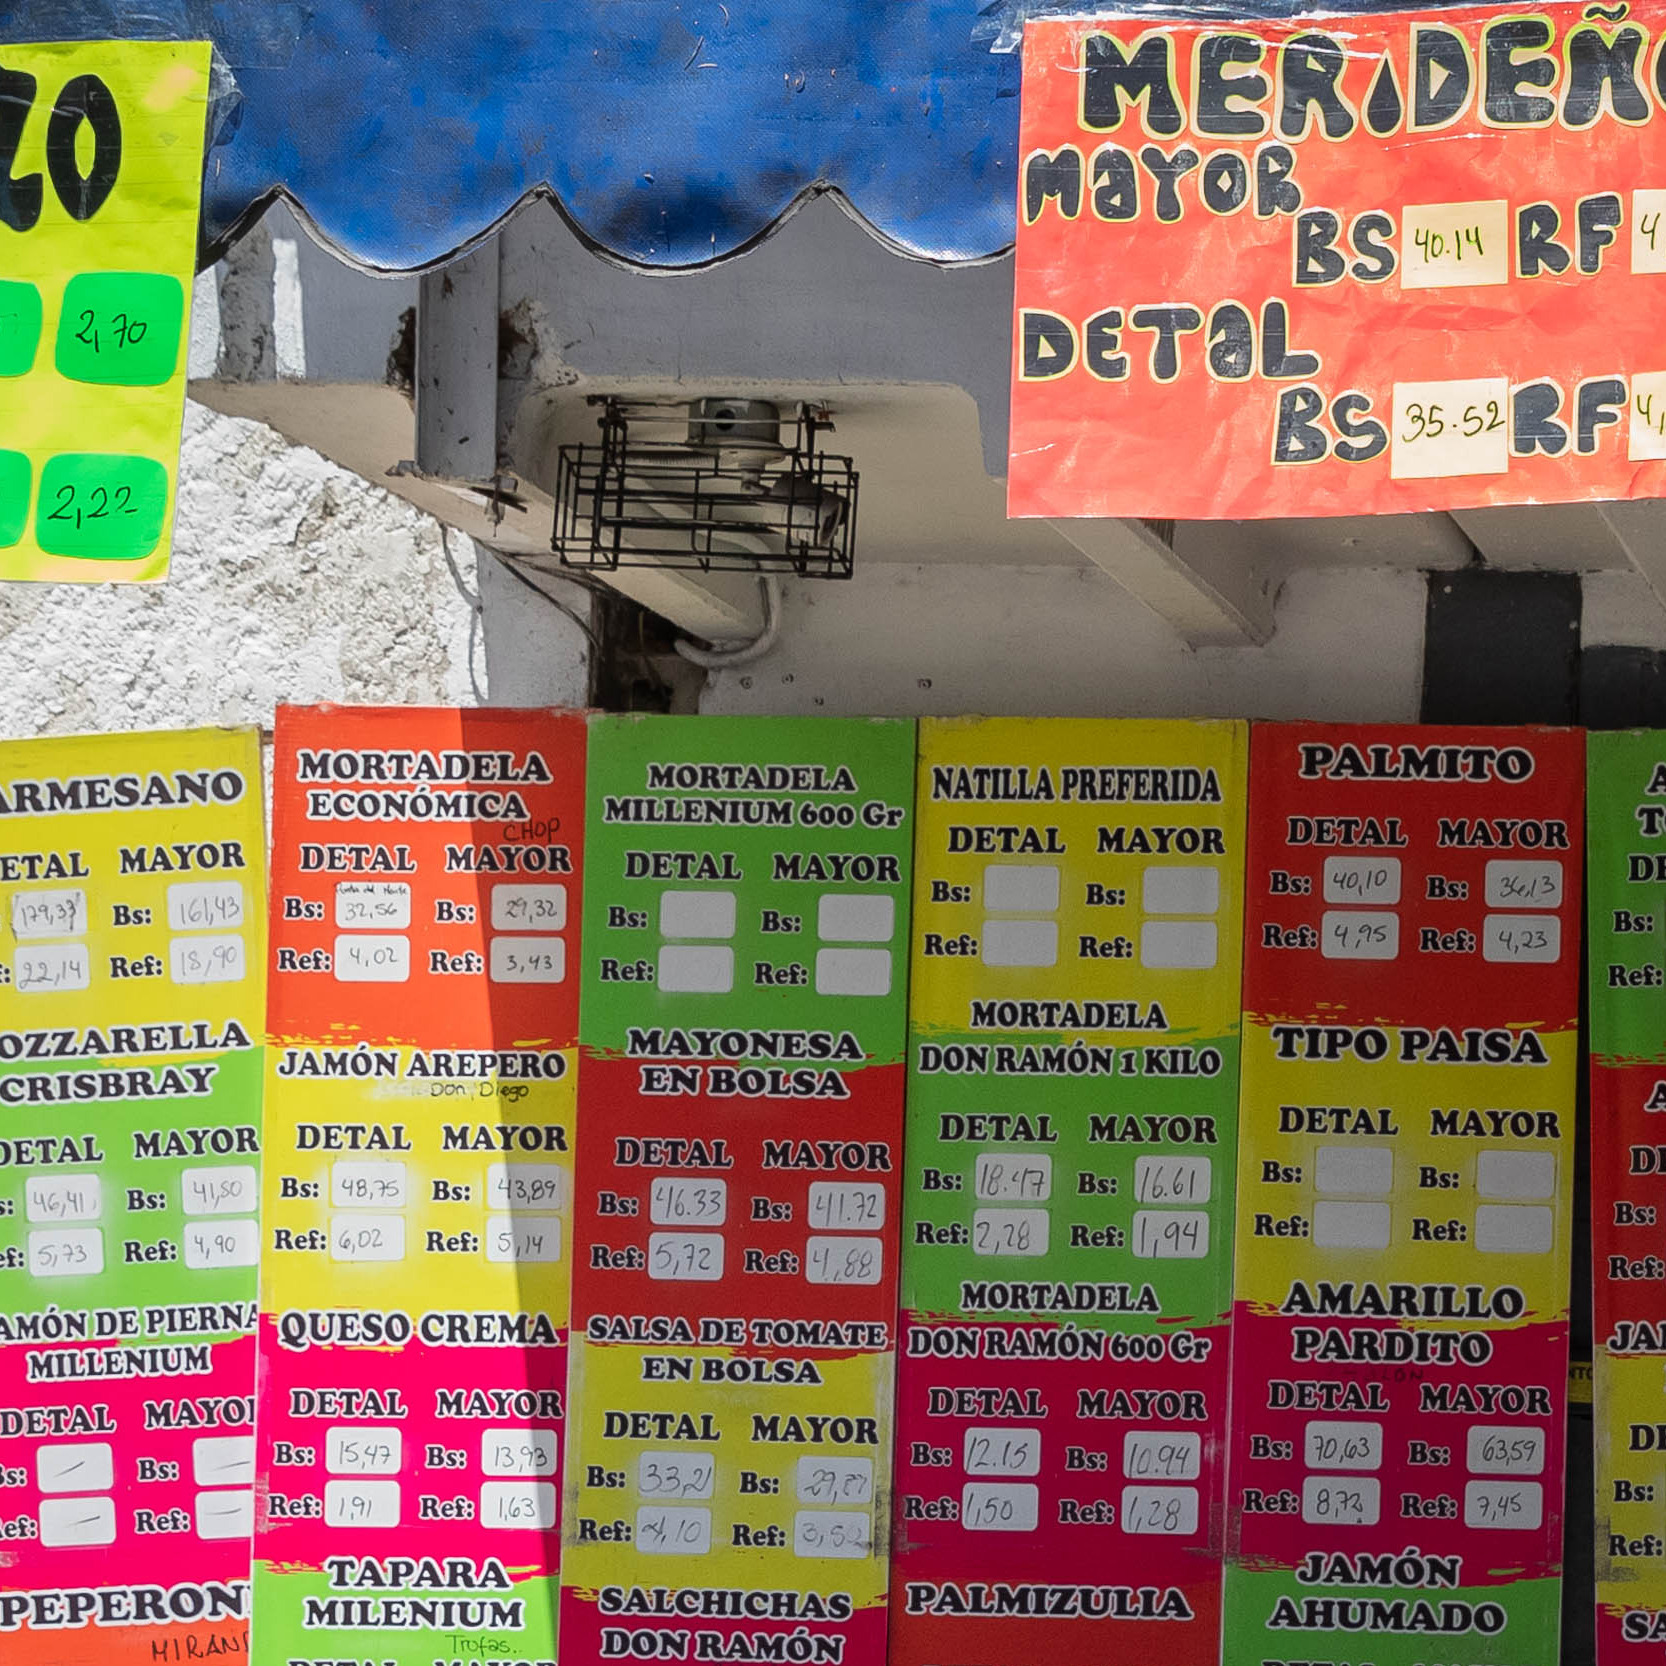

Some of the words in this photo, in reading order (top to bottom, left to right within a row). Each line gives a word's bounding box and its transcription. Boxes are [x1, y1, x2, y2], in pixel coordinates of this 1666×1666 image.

[1294, 207, 1398, 287] BS
[1415, 227, 1482, 258] 40.14
[1517, 193, 1622, 276] RF
[78, 310, 147, 344] 2,70
[1273, 384, 1388, 465] BS
[1403, 401, 1505, 441] 35.52
[1510, 376, 1627, 458] RF
[48, 487, 137, 521] 2,22
[298, 751, 551, 784] MORTADELA
[648, 765, 856, 792] MORTADELA
[1299, 745, 1534, 782] PALMITO
[933, 767, 1057, 802] NATILLA
[1062, 767, 1221, 803] PREFERIDA
[310, 788, 529, 821] ECONÓMICA
[604, 798, 793, 826] MILLENIUM
[799, 803, 855, 827] 600
[861, 803, 903, 827] Gr
[1286, 818, 1407, 847] DETAL
[1437, 819, 1569, 849] MAYOR
[119, 842, 245, 874] MAYOR
[301, 846, 416, 873] DETAL
[445, 846, 572, 873] MAYOR
[1270, 870, 1311, 895] Bs:
[113, 905, 152, 926] Bs:
[1262, 923, 1317, 950] Ref:
[110, 954, 163, 977] Ref:
[970, 1001, 1168, 1031] MORTADELA
[279, 1044, 398, 1078] JAMÓN
[407, 1052, 565, 1079] AREPERO
[627, 1029, 863, 1061] MAYONESA
[919, 1046, 993, 1075] DON
[995, 1039, 1117, 1075] RAMÓN
[1144, 1048, 1221, 1076] KILO
[1273, 1026, 1388, 1062] TIPO
[1399, 1027, 1548, 1065] PAISA
[639, 1069, 701, 1096] EN
[707, 1069, 849, 1098] BOLSA
[341, 1177, 400, 1199] 48,75
[497, 1177, 557, 1204] 43,89
[961, 1283, 1160, 1313] MORTADELA
[1280, 1282, 1524, 1320] AMARILLO
[96, 1310, 138, 1337] DE
[282, 1312, 409, 1348] QUESO
[420, 1312, 559, 1345] CREMA
[588, 1316, 695, 1345] SALSA
[700, 1319, 747, 1345] DE
[752, 1320, 886, 1349] TOMATE
[908, 1327, 981, 1358] DON
[986, 1322, 1103, 1360] RAMÓN
[1110, 1335, 1164, 1360] 600
[1171, 1332, 1211, 1363] Gr
[1292, 1329, 1492, 1365] PARDITO
[30, 1346, 211, 1381] MILLENIUM
[642, 1358, 697, 1382] EN
[701, 1357, 821, 1384] BOLSA
[328, 1556, 510, 1590] TAPARA
[1297, 1547, 1460, 1588] JAMÓN
[305, 1599, 523, 1629] MILENIUM
[599, 1587, 851, 1620] SALCHICHAS
[906, 1584, 1194, 1620] PALMIZULIA
[1267, 1599, 1505, 1634] AHUMADO
[601, 1629, 690, 1660] DON
[695, 1628, 845, 1665] RAMÓN
